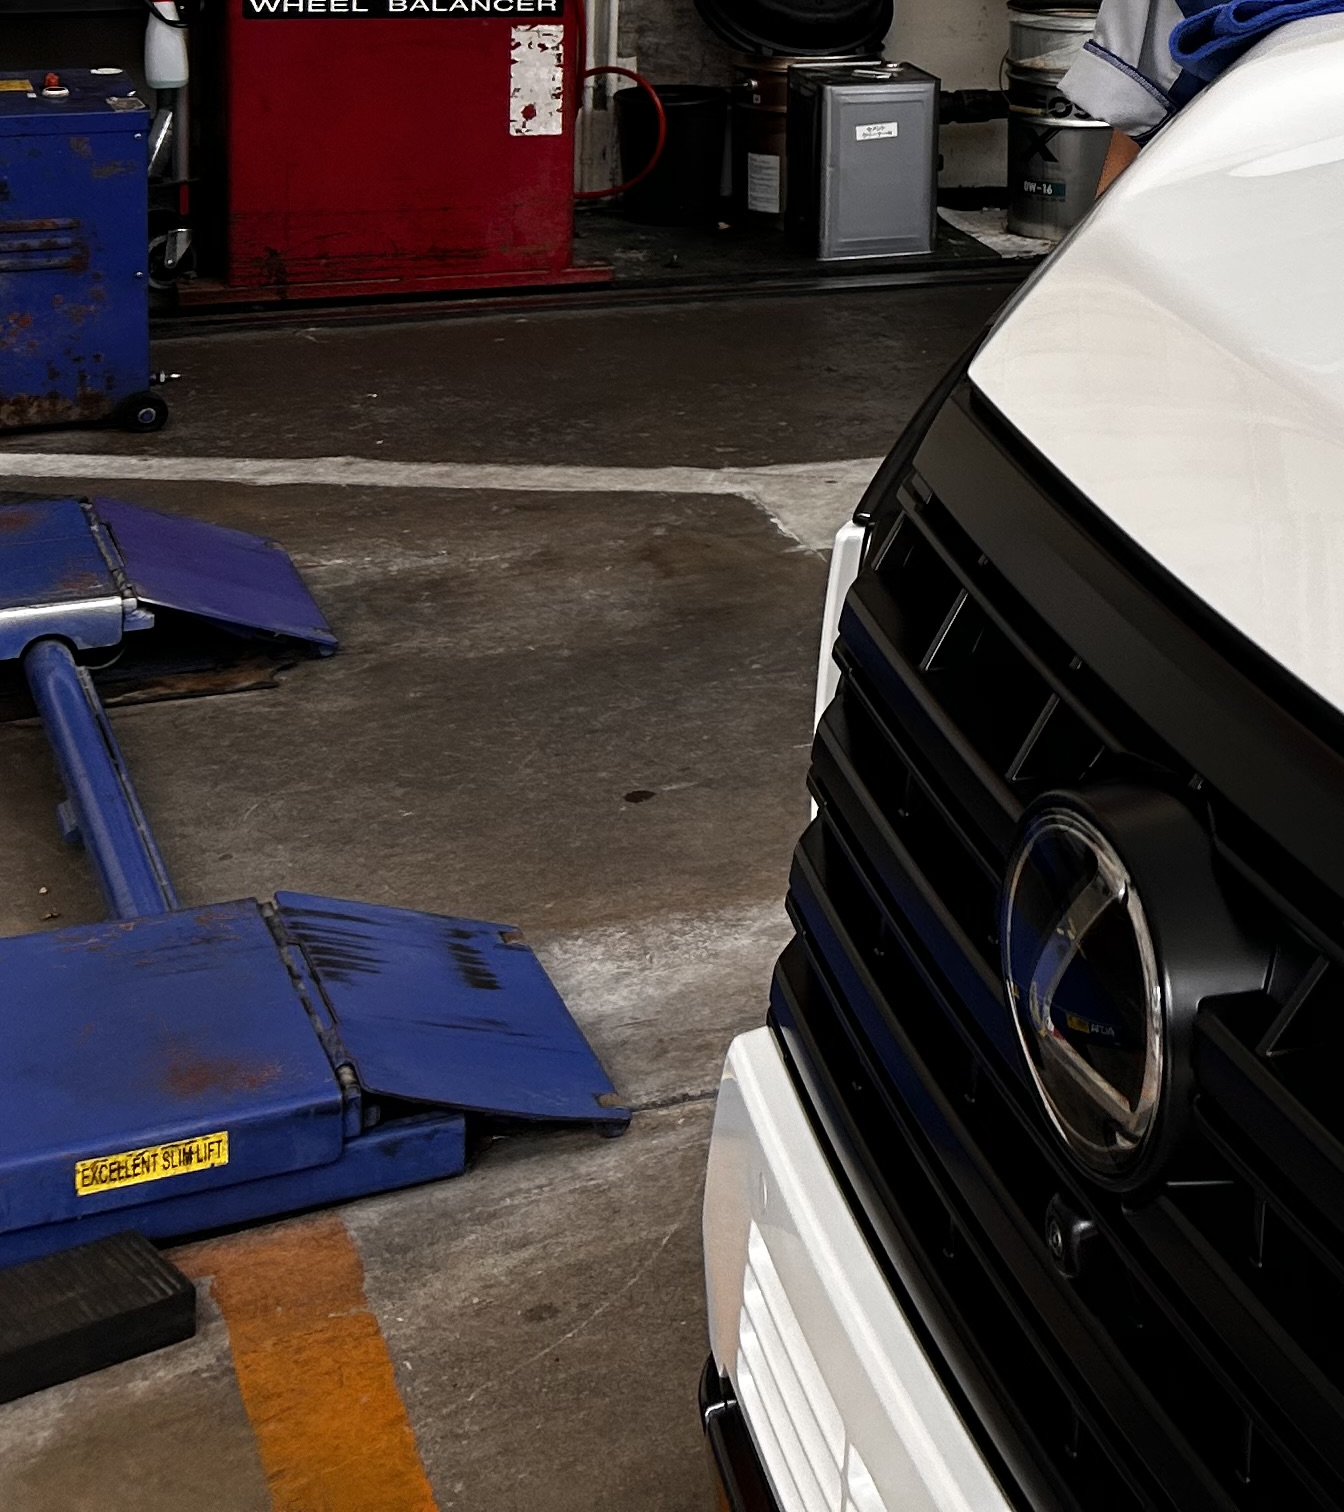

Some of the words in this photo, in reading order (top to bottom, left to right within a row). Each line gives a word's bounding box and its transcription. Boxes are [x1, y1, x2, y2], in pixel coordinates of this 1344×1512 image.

[1023, 180, 1053, 196] 0W-16
[82, 1153, 159, 1188] EXCELLENT
[195, 1140, 223, 1164] LIFT
